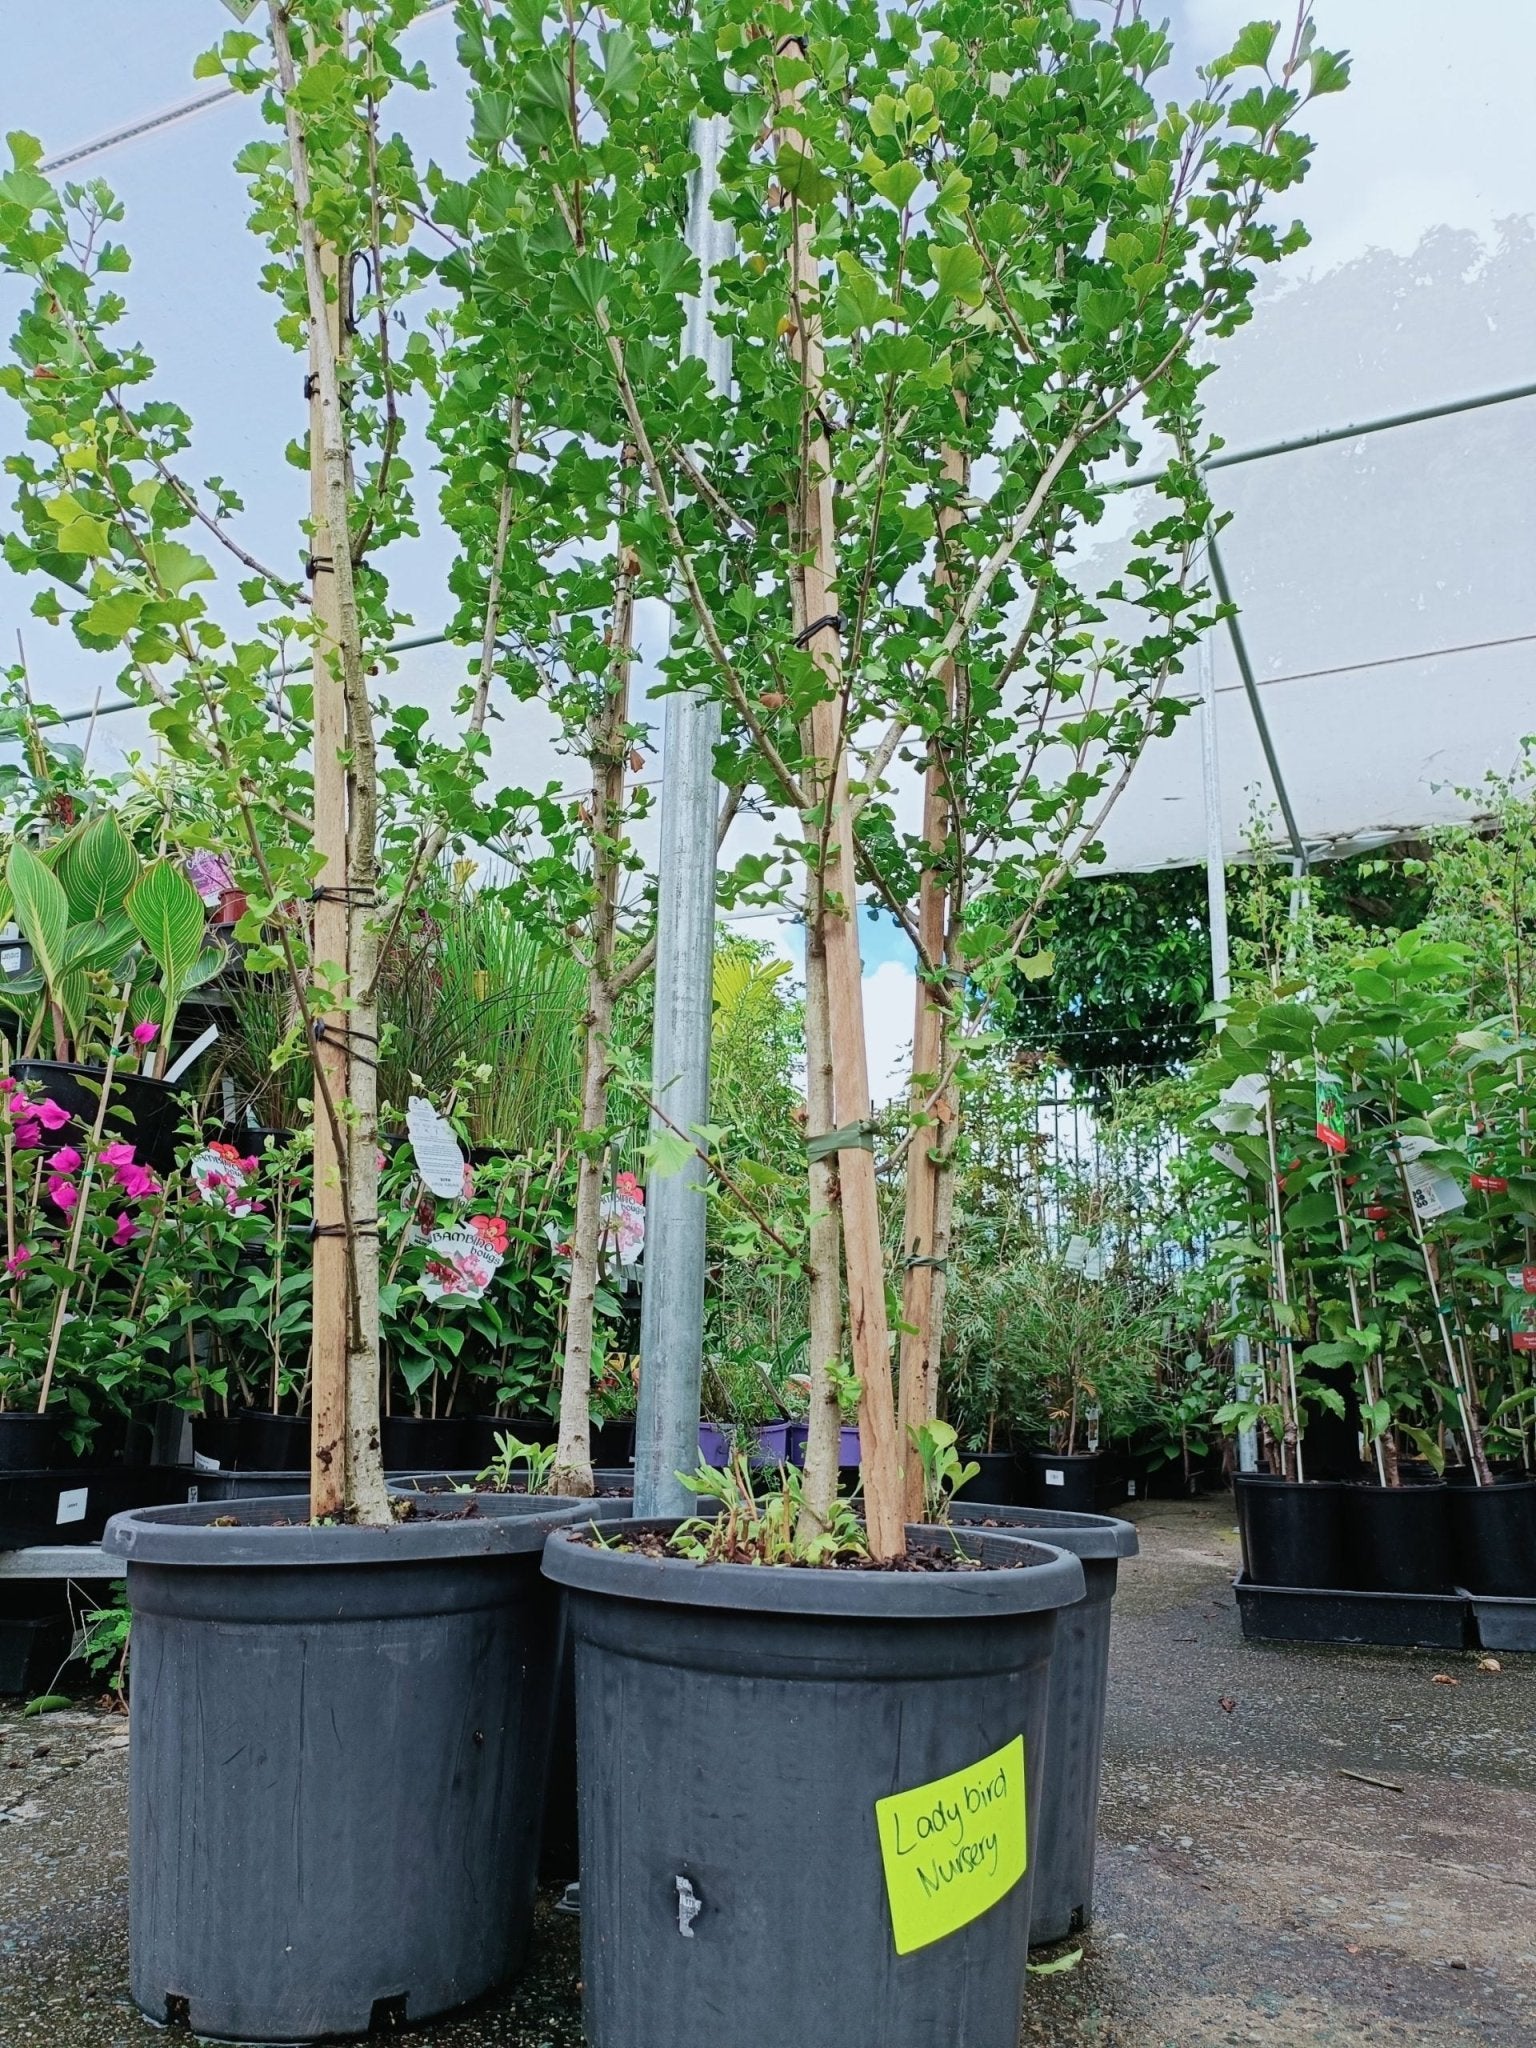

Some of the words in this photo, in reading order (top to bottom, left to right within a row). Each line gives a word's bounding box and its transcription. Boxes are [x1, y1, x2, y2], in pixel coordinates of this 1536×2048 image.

[432, 1231, 494, 1252] BAMBINO
[470, 1245, 500, 1265] bougs
[916, 1832, 999, 1898] Nursery
